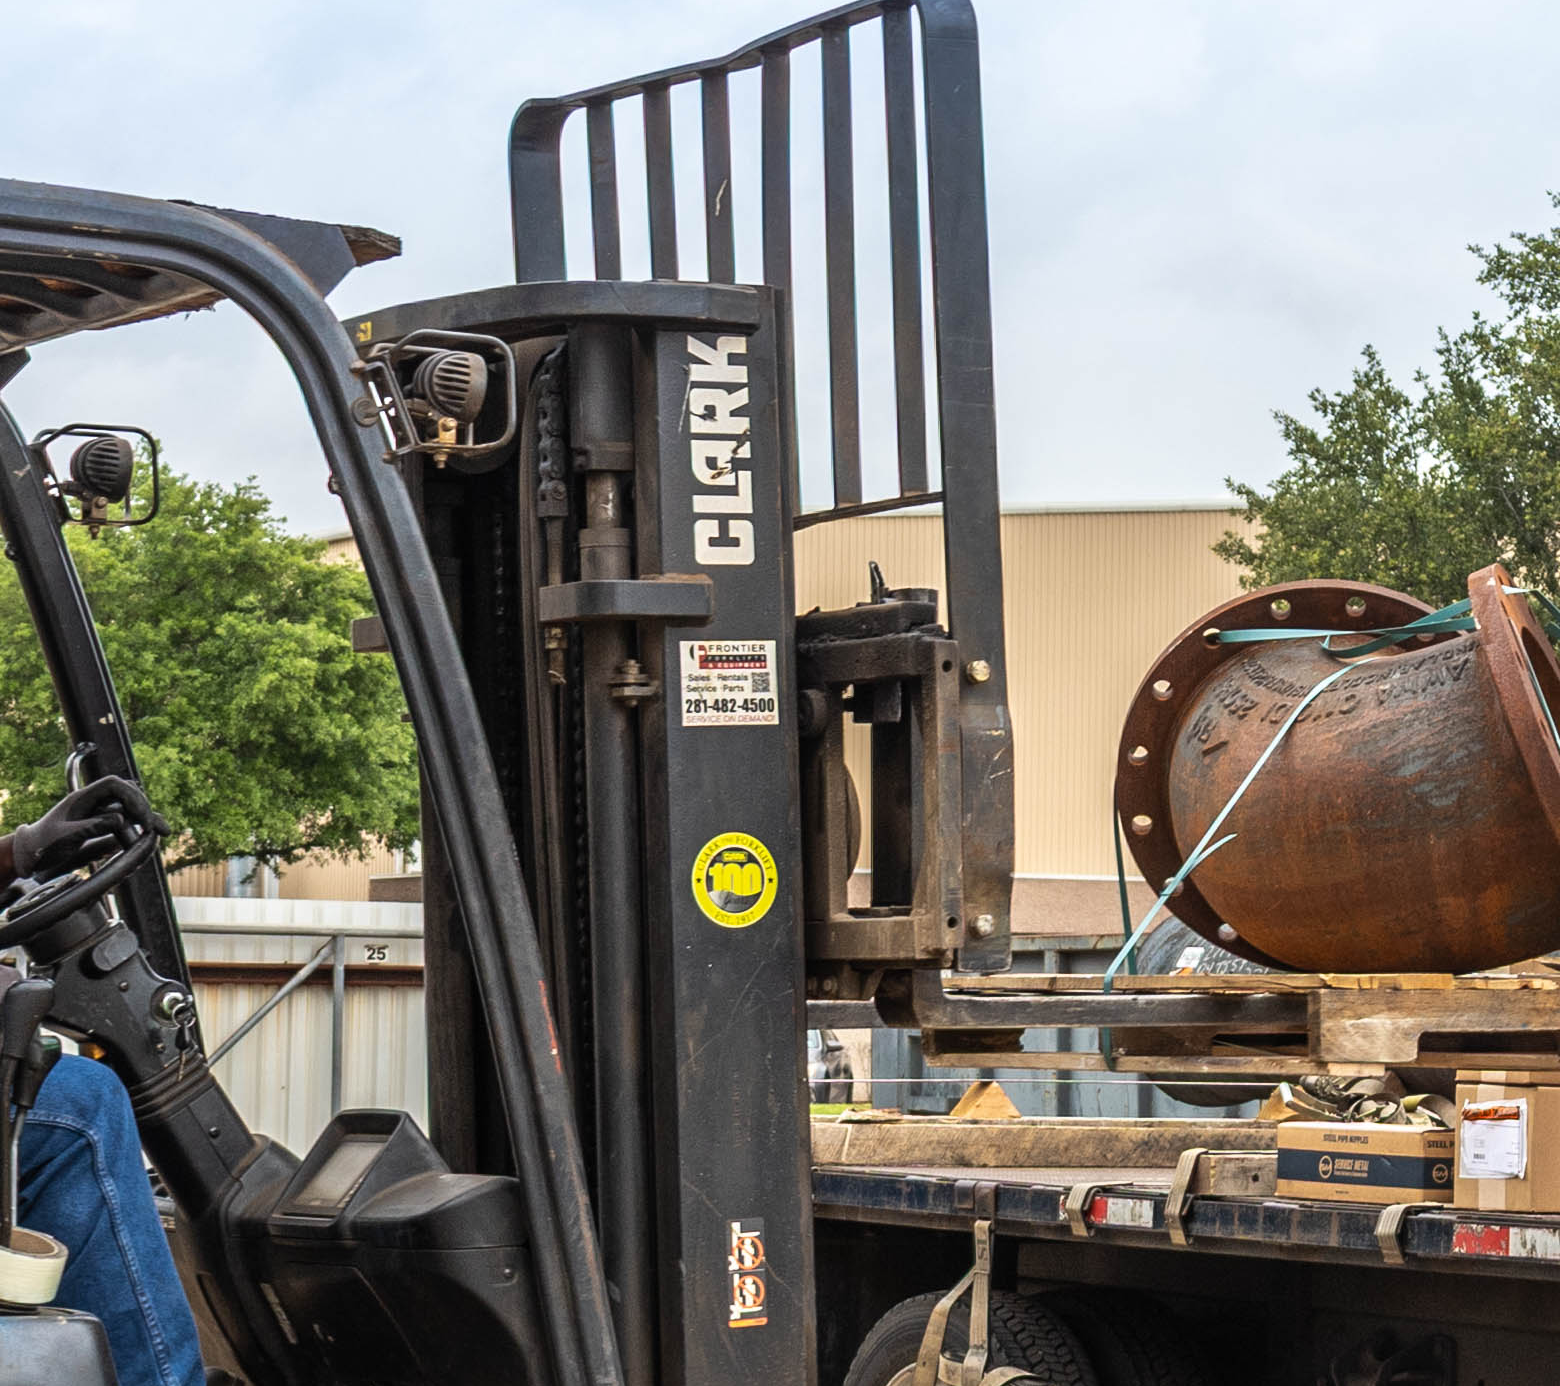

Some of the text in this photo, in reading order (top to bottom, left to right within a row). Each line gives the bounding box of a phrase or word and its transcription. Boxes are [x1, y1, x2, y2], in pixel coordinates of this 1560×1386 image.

[687, 335, 755, 565] CLARK
[708, 644, 766, 652] FRONTIER
[688, 673, 711, 682] Sales
[686, 684, 744, 693] Service Parts
[685, 698, 775, 713] 281-482-4500
[709, 862, 762, 896] 100
[367, 945, 386, 960] 25
